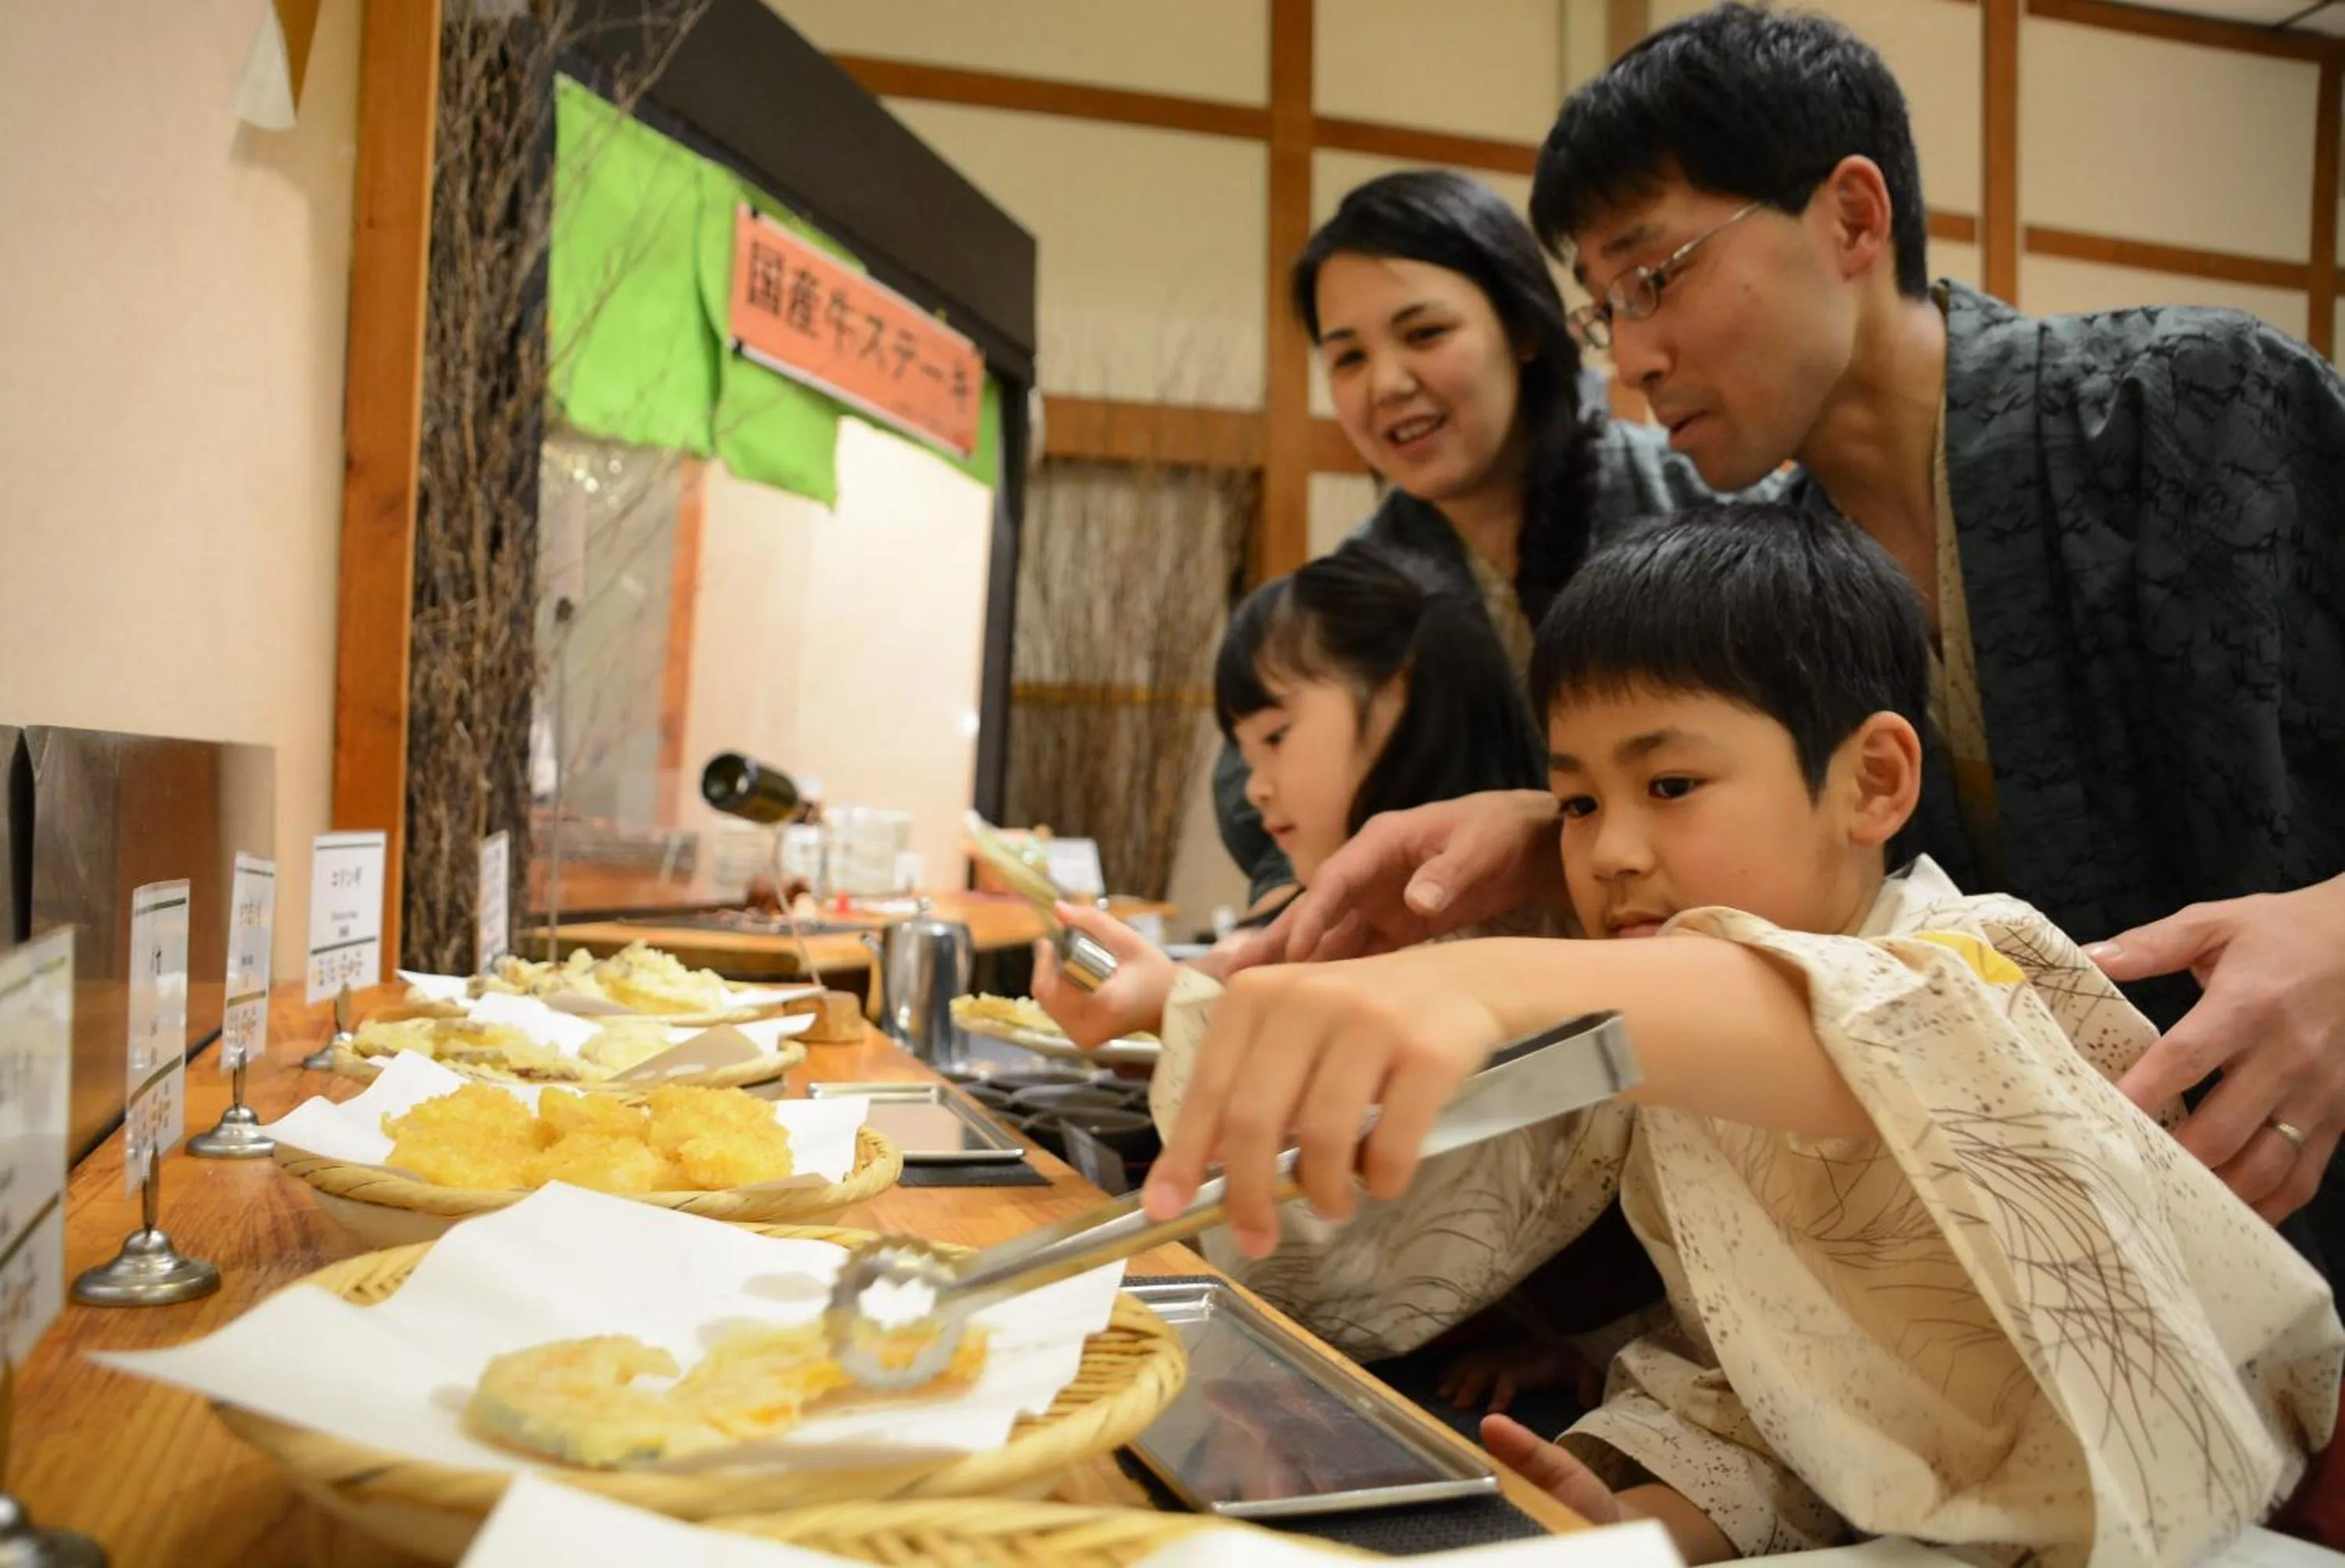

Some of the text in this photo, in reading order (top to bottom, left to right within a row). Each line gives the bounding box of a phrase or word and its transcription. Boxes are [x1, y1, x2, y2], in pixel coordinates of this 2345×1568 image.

[747, 240, 970, 414] 国産牛ステーキ
